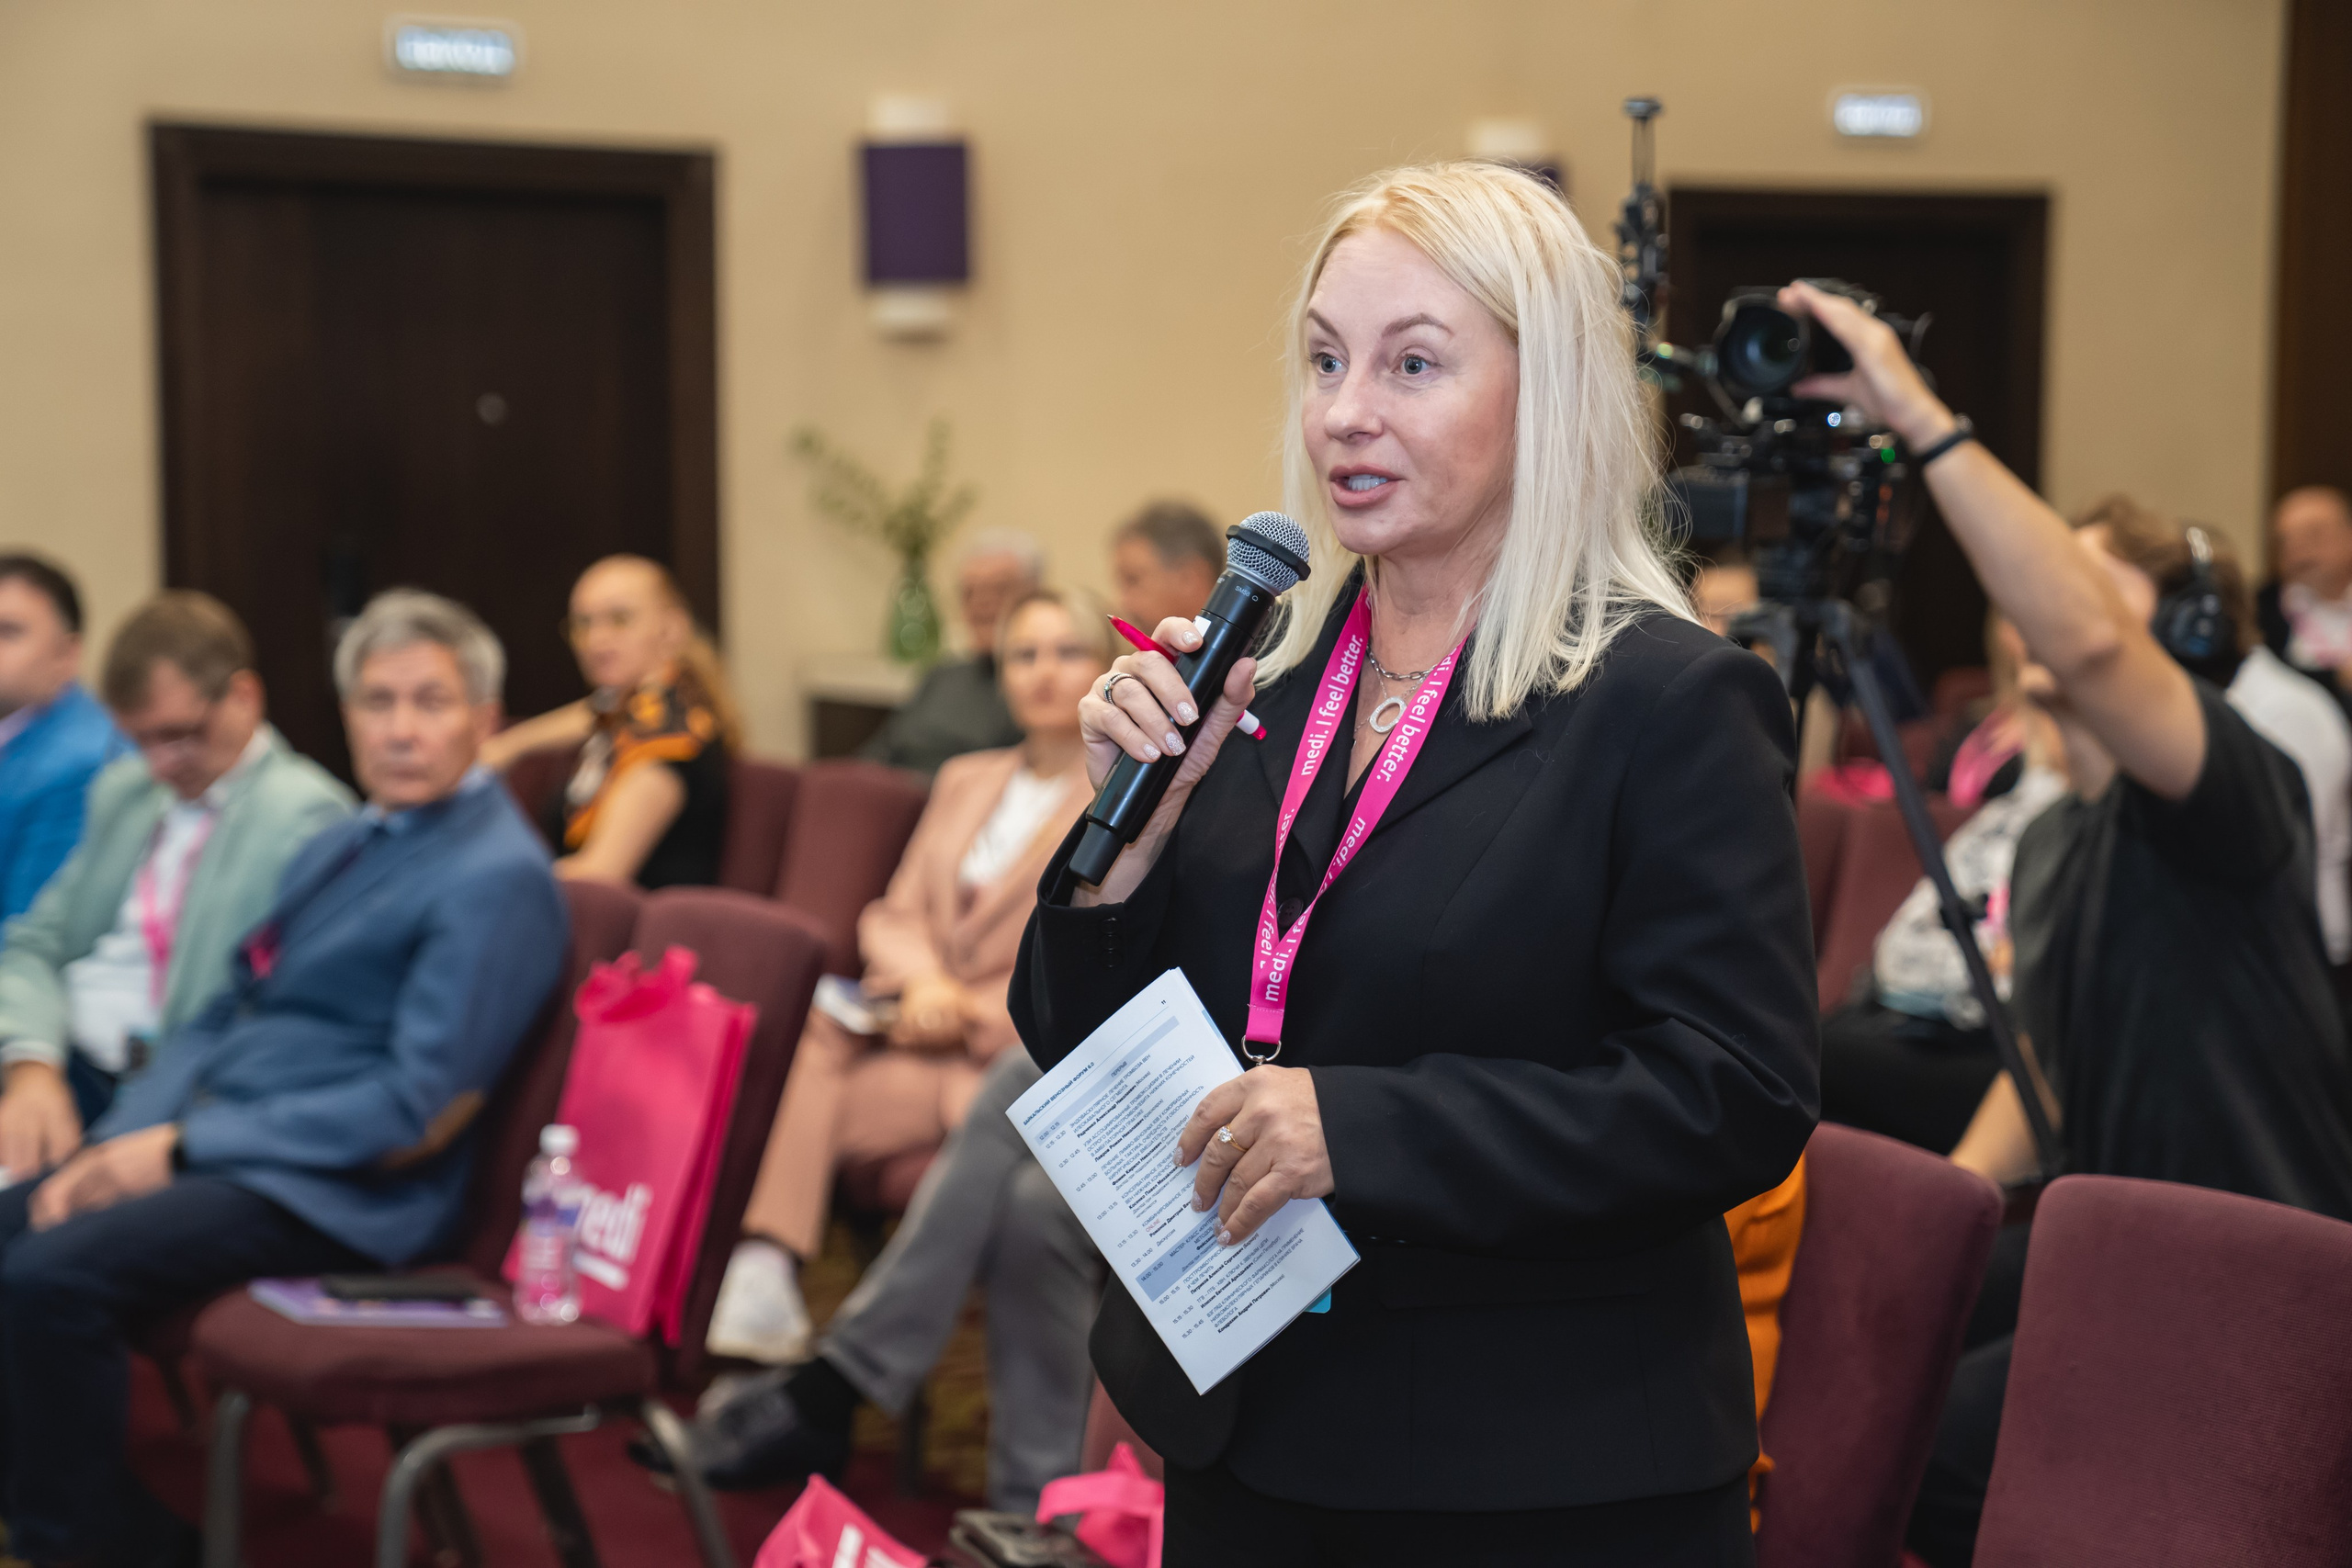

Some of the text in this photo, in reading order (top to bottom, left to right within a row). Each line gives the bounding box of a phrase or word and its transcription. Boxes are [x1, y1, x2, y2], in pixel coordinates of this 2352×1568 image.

[1331, 635, 1363, 685] better.
[1318, 684, 1345, 716] feel
[1408, 689, 1438, 723] feel
[1301, 730, 1329, 775] medi.
[1376, 723, 1421, 783] better.
[1333, 817, 1365, 867] medi.
[1261, 920, 1274, 956] feel
[1265, 948, 1292, 1001] medi.
[1049, 1079, 1073, 1101] ВЕНОЗНЫЙ
[1071, 1066, 1088, 1082] ФОРУМ
[1107, 1078, 1124, 1095] ЛЕЧЕНИЕ
[1123, 1060, 1142, 1080] ТРОМБОЗА
[1141, 1054, 1150, 1063] ВЕН
[1109, 1083, 1128, 1101] СЕГМЕНТА
[1109, 1136, 1122, 1149] Роман
[1121, 1117, 1144, 1138] Николаевич
[1125, 1108, 1144, 1127] ПРАКТИКЕ
[1039, 1130, 1049, 1141] 12.00
[1100, 1153, 1119, 1170] ЛЕЧЕНИЕ
[1125, 1159, 1140, 1174] Кирилл
[1139, 1140, 1162, 1162] Николаевич
[1096, 1210, 1107, 1220] 13.00
[1125, 1195, 1134, 1204] ВЕН
[1184, 1229, 1199, 1243] КЛАСС
[1152, 1260, 1163, 1271] 15.00
[1190, 1276, 1199, 1286] ЧЕМ
[1198, 1264, 1214, 1279] ЛЕЧИТЬ
[1207, 1263, 1224, 1279] Алексей
[1223, 1246, 1243, 1266] Сергеевич
